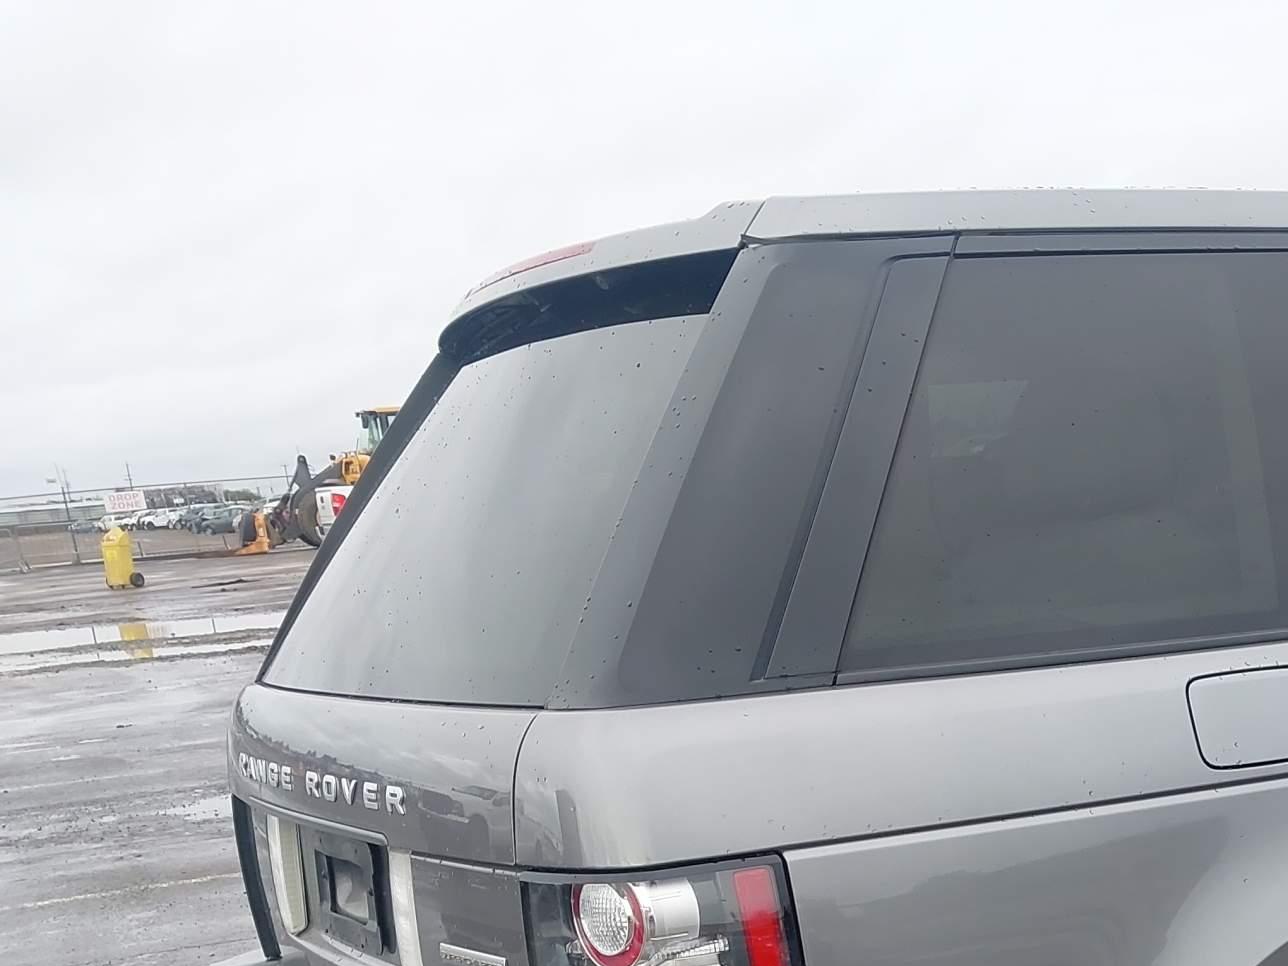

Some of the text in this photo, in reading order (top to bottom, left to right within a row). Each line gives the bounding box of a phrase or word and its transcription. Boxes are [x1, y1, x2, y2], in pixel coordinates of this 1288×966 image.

[108, 493, 138, 502] DROP
[238, 752, 406, 815] RANGE ROVER
